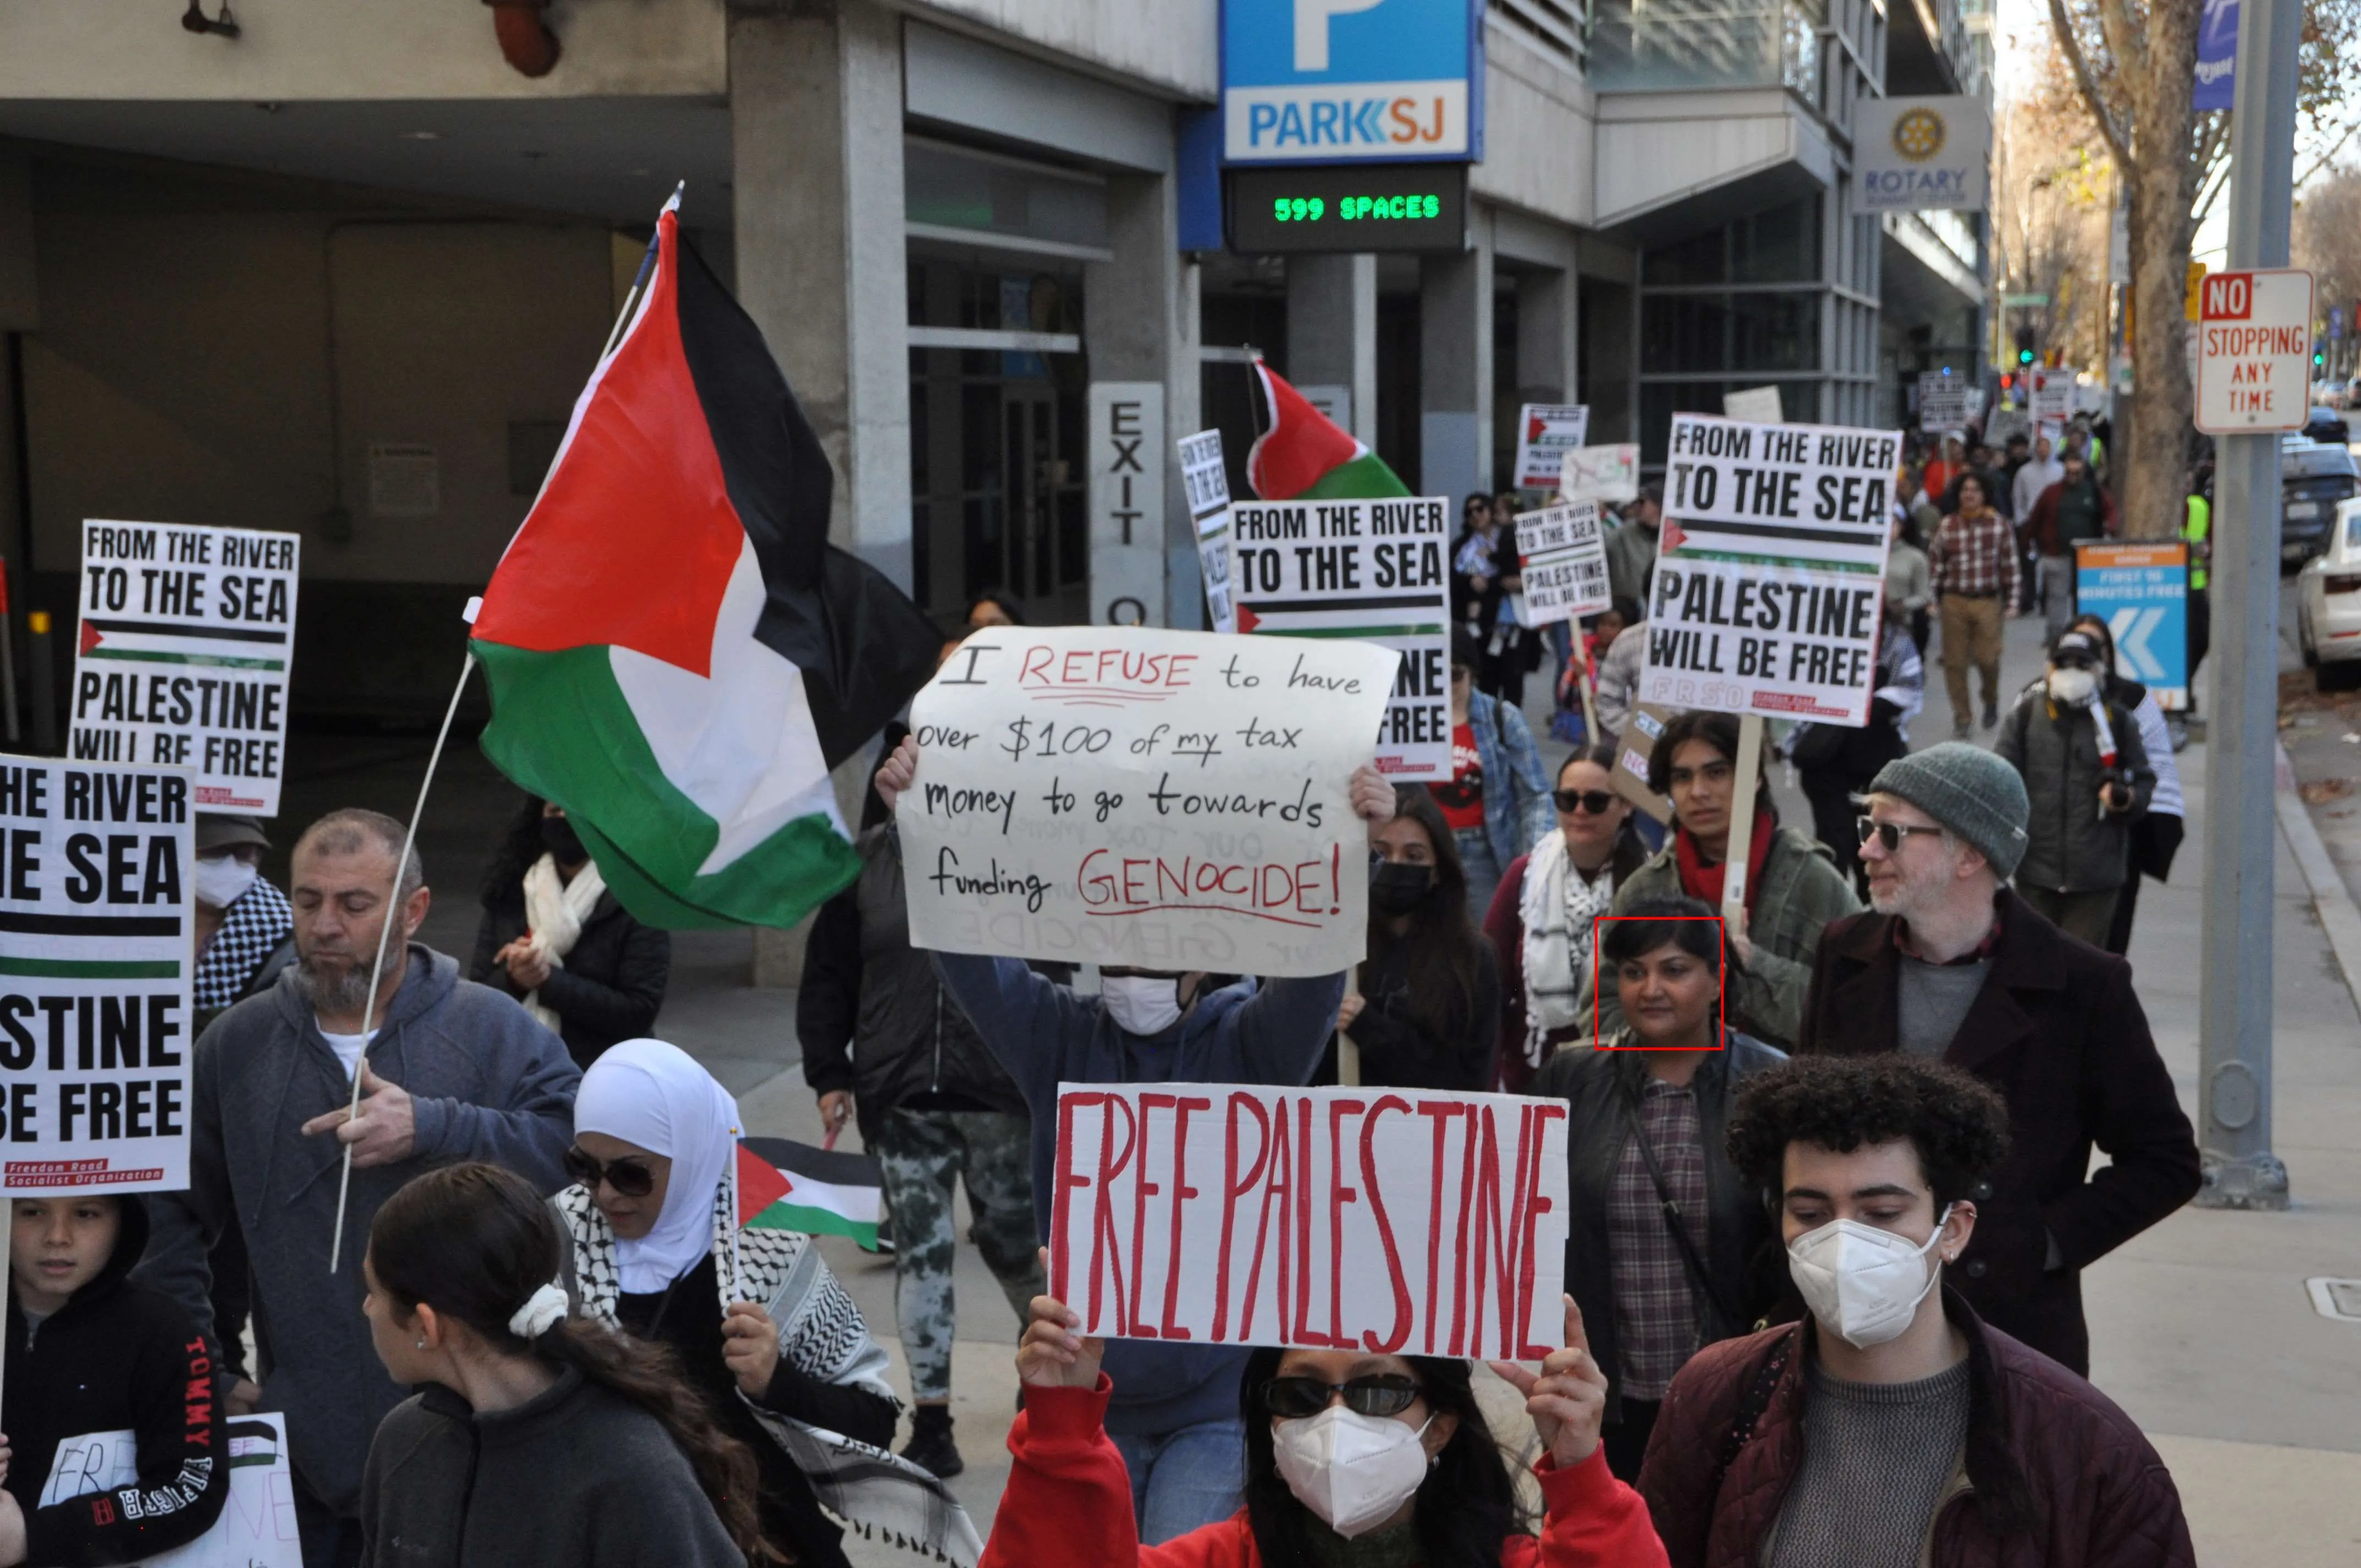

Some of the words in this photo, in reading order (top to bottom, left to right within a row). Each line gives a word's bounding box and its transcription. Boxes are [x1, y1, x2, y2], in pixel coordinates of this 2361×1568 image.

[1865, 168, 1967, 192] ROTARY
[1275, 198, 1324, 221] 599
[1340, 195, 1439, 220] SPACES
[2208, 278, 2247, 315] NO
[2207, 325, 2304, 357] STOPPING
[2232, 363, 2273, 384] ANY
[2229, 390, 2274, 412] TIME
[1673, 423, 1751, 460] FROM
[1762, 429, 1809, 463] THE
[1818, 434, 1896, 470] RIVER
[1110, 401, 1144, 545] EXIT
[1674, 463, 1717, 510] TO
[1733, 469, 1802, 518] THE
[1814, 476, 1886, 525] SEA
[1235, 508, 1307, 540] FROM
[1316, 506, 1361, 537] THE
[1372, 503, 1443, 535] RIVER
[1542, 526, 1565, 545] THE
[1571, 520, 1596, 539] SEA
[88, 526, 155, 561] FROM
[167, 531, 211, 564] THE
[222, 536, 294, 571] RIVER
[1237, 548, 1281, 594] TO
[1294, 546, 1360, 591] THE
[1374, 542, 1443, 589] SEA
[86, 565, 128, 612] TO
[141, 569, 206, 616] THE
[220, 575, 287, 623] SEA
[1526, 559, 1603, 590] PALESTINE
[2147, 583, 2185, 598] FREE
[1530, 592, 1556, 607] WILL
[1655, 570, 1874, 639] PALESTINE
[940, 646, 1002, 684] I
[1019, 646, 1198, 686] REFUSE
[1220, 658, 1260, 688] to
[1287, 654, 1362, 694] have
[1390, 650, 1443, 696] NE
[1650, 628, 1724, 673] WILL
[1737, 637, 1778, 678] BE
[1788, 643, 1869, 688] FREE
[78, 672, 282, 732] PALESTINE
[204, 736, 278, 778] FREE
[916, 725, 978, 750] over
[999, 715, 1113, 762] $100
[1130, 724, 1170, 755] of
[1177, 733, 1218, 767] my
[1236, 717, 1303, 749] tax
[64, 771, 186, 823] RIVER
[925, 783, 1016, 834] money
[1042, 776, 1075, 815] to
[1095, 793, 1123, 821] go
[1149, 772, 1323, 827] towards
[65, 833, 181, 904] SEA
[928, 846, 1051, 912] funding
[1078, 842, 1340, 914] GENOCIDE!
[59, 1080, 183, 1141] FREE
[9, 1163, 64, 1173] Freedom
[72, 1160, 104, 1172] Road
[9, 1175, 69, 1185] Socialist
[76, 1169, 161, 1184] Organization
[1051, 1092, 1211, 1340] FREE
[1211, 1092, 1566, 1361] PALESTINE
[185, 1336, 212, 1447] TOMMY
